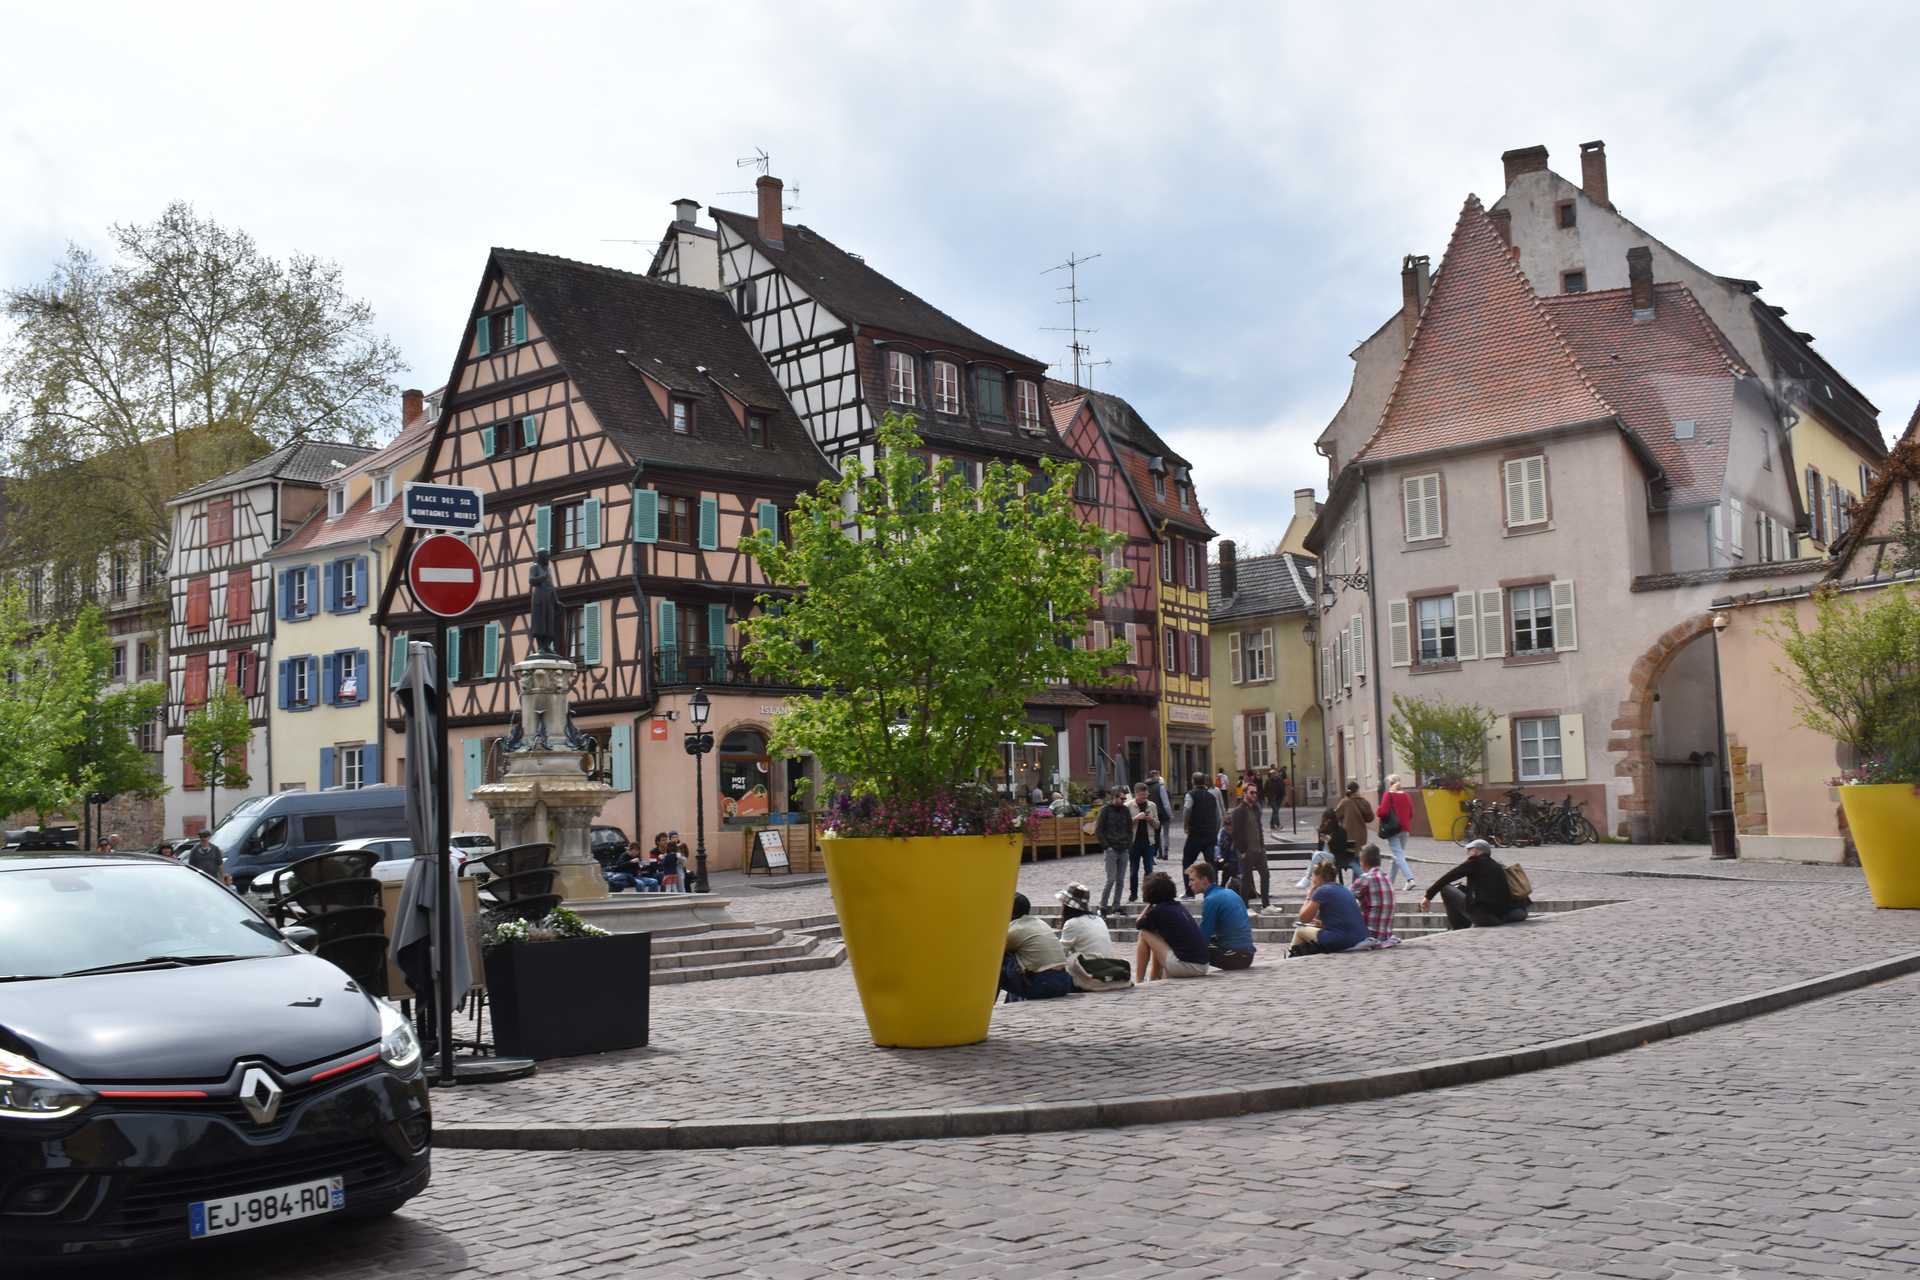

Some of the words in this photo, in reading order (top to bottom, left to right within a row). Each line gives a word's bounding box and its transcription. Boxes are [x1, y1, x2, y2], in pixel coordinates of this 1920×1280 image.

[415, 494, 437, 503] PLACE
[441, 496, 455, 505] DES
[460, 498, 471, 506] SIX
[411, 508, 449, 518] MONTAGNES
[454, 511, 477, 520] NOIRES
[731, 776, 746, 784] HOT
[208, 1185, 329, 1230] EJ-984-RQ
